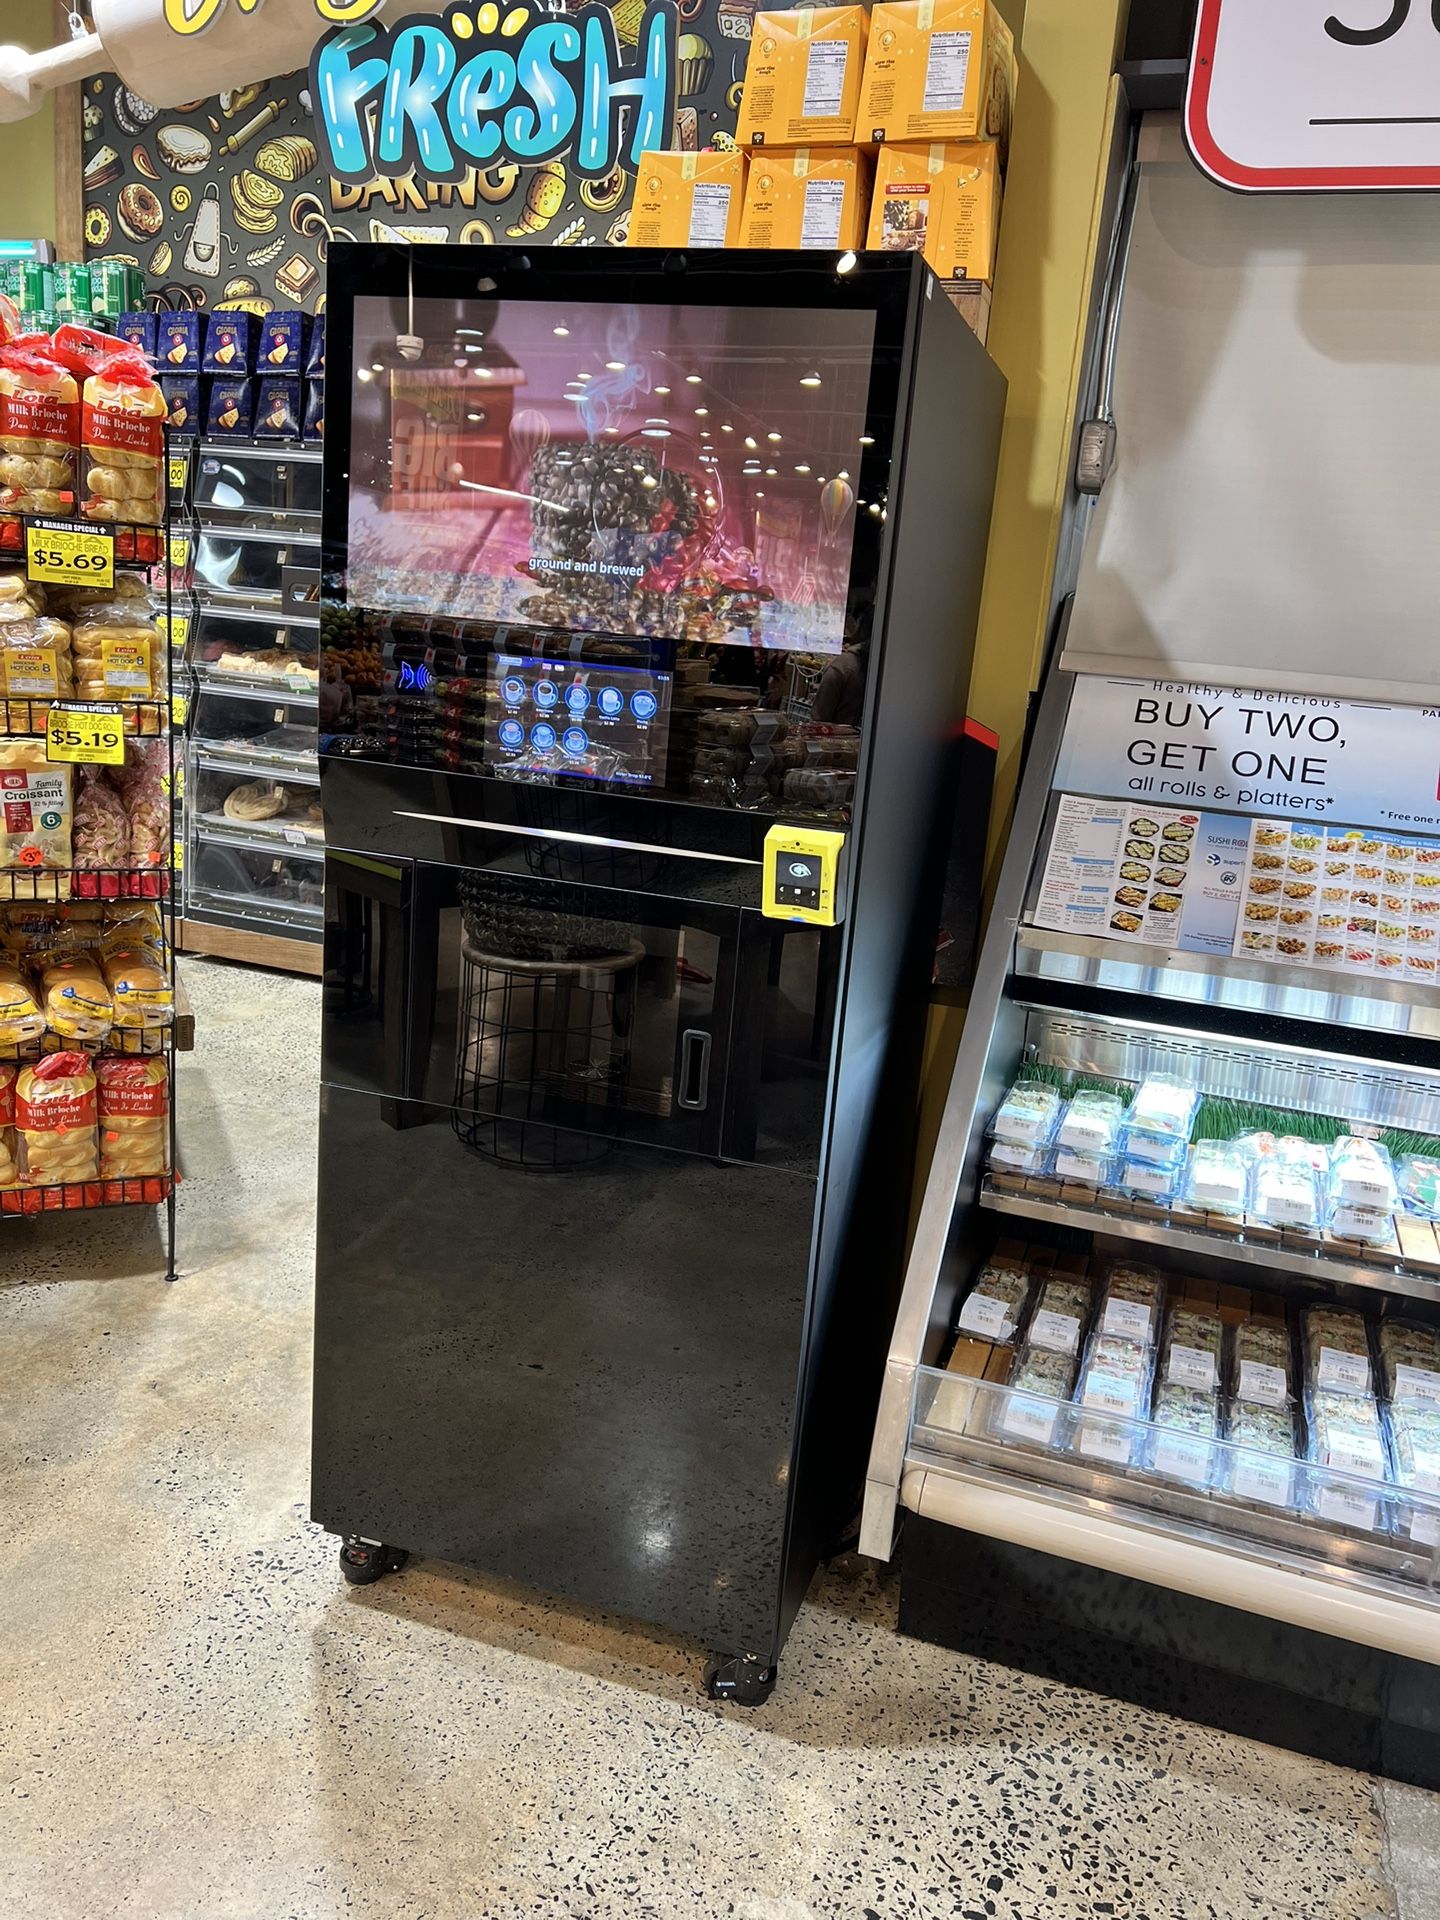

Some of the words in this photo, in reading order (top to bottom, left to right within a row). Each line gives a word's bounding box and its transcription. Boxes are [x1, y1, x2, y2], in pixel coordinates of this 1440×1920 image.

[8, 403, 29, 416] Milk
[31, 406, 68, 420] Brioche
[8, 416, 28, 430] Pan
[92, 413, 112, 426] Milk
[113, 418, 150, 434] Brioche
[92, 427, 110, 440] Pan
[42, 520, 72, 531] MANAGER
[74, 524, 99, 534] SPECIAL
[32, 538, 50, 549] MILK
[50, 540, 83, 552] BRIOCHE
[84, 544, 109, 555] BREAD
[34, 548, 108, 571] $5.69
[528, 558, 571, 570] ground
[574, 561, 597, 572] and
[600, 562, 644, 576] brewed
[136, 656, 145, 666] 8
[42, 663, 51, 673] 8
[1152, 680, 1223, 700] Healthy
[1232, 688, 1243, 700] &
[1254, 690, 1341, 709] Delicious
[88, 705, 112, 714] SPECIAL
[74, 722, 88, 730] HOT
[88, 722, 102, 732] DOG
[1134, 698, 1224, 730] BUY
[1238, 708, 1346, 748] TWO,
[51, 729, 119, 748] $5.19
[1127, 739, 1217, 772] GET
[1231, 750, 1328, 785] ONE
[35, 778, 63, 790] Family
[1128, 776, 1154, 791] all
[1160, 776, 1206, 798] rolls
[1213, 786, 1230, 800] &
[4, 789, 64, 801] Croissant
[46, 814, 56, 826] 6
[1388, 811, 1411, 822] Free
[1413, 815, 1434, 824] one
[1207, 835, 1230, 846] SUSHI
[102, 1090, 119, 1100] Milk
[121, 1090, 154, 1100] Brioche
[28, 1107, 46, 1117] Milk
[48, 1104, 81, 1116] Brioche
